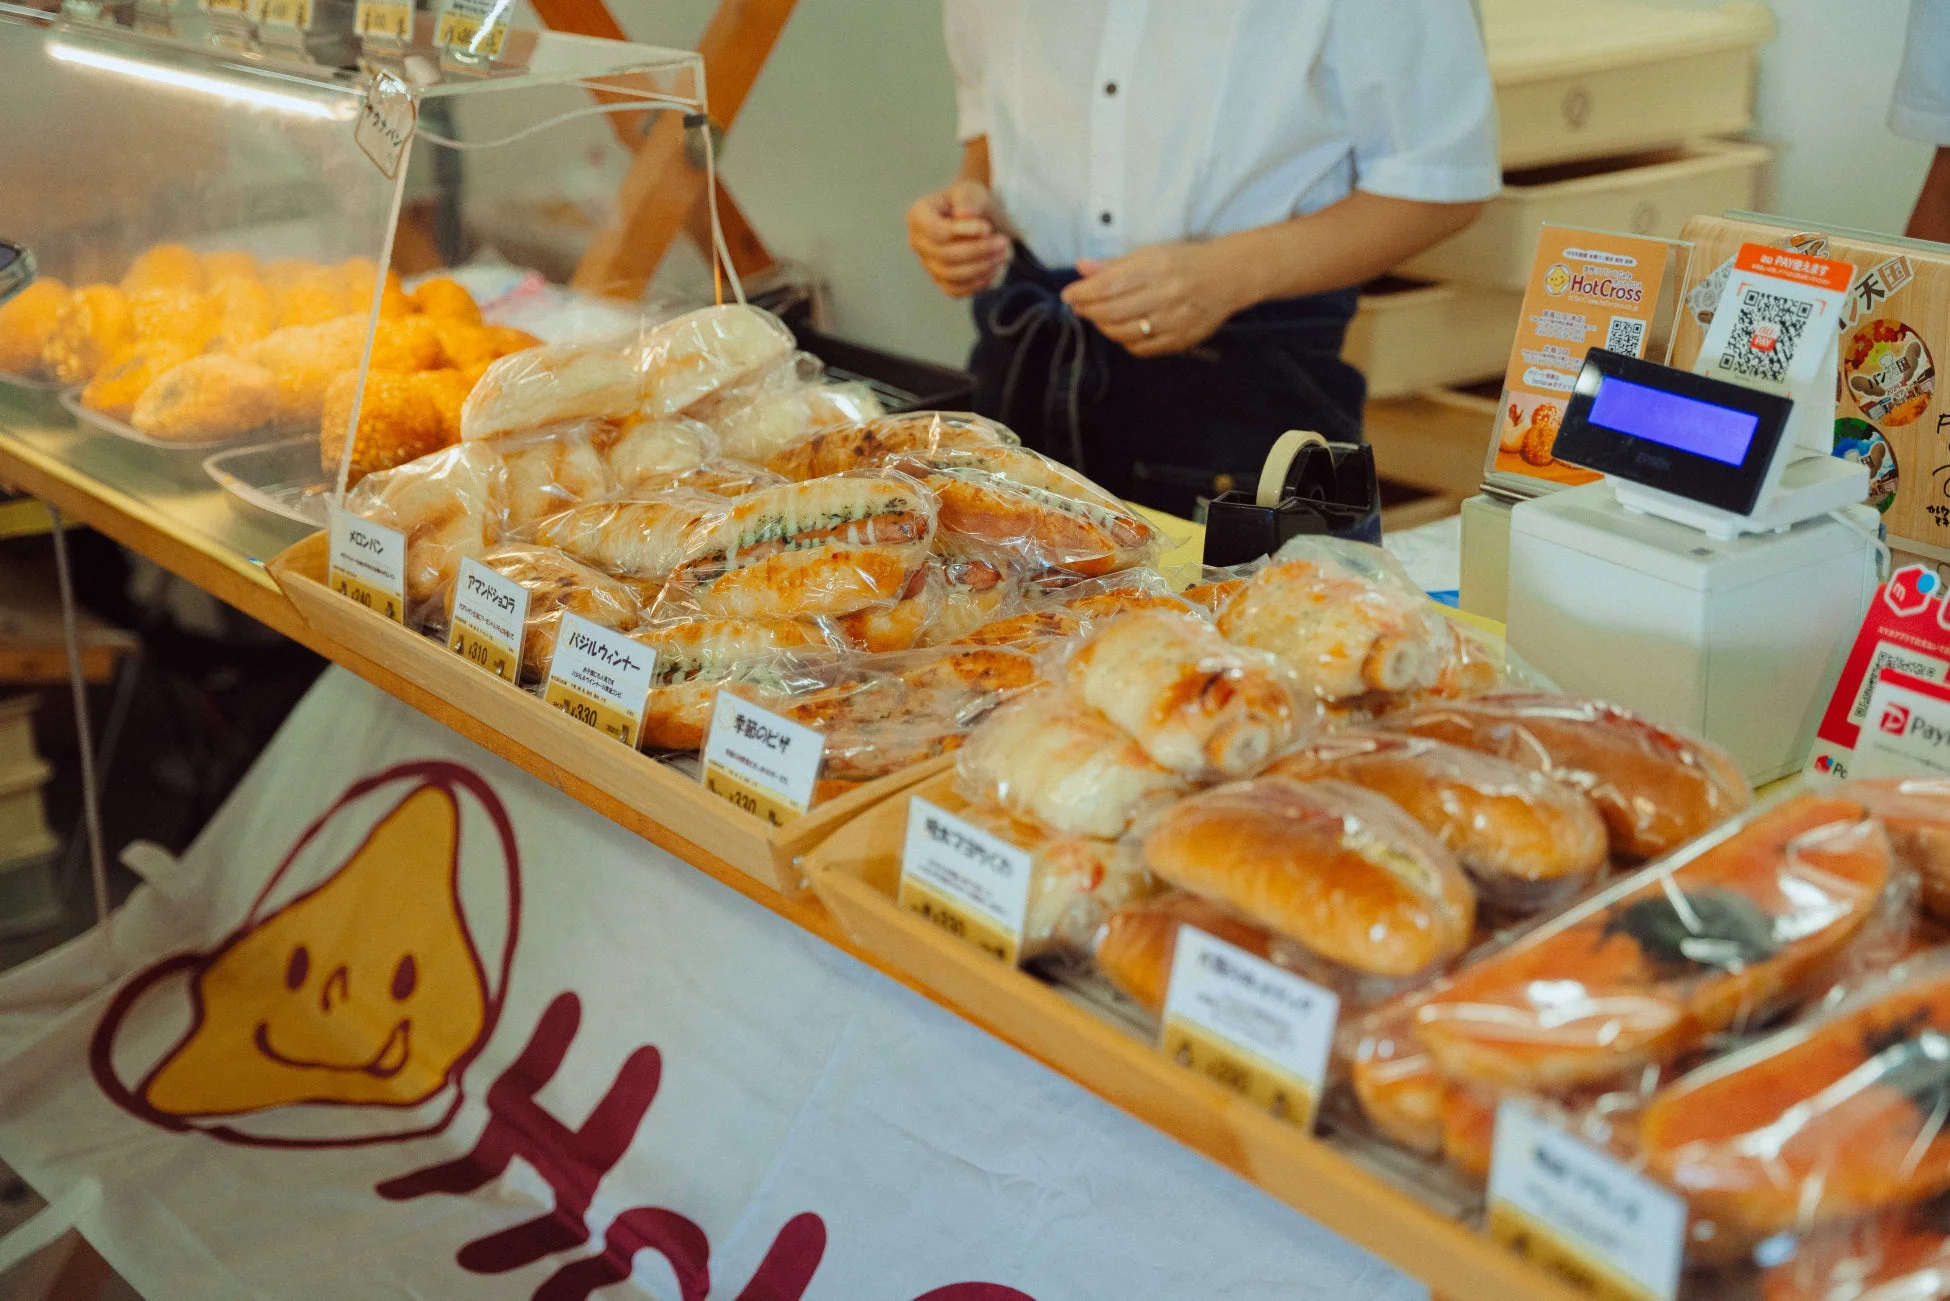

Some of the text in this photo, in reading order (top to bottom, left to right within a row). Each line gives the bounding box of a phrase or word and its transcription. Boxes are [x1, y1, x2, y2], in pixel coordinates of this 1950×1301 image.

[1571, 274, 1643, 302] HotCross
[349, 530, 385, 555] メロンパン
[469, 575, 516, 614] アマンドショコラ
[569, 631, 640, 671] バジルウィンナー
